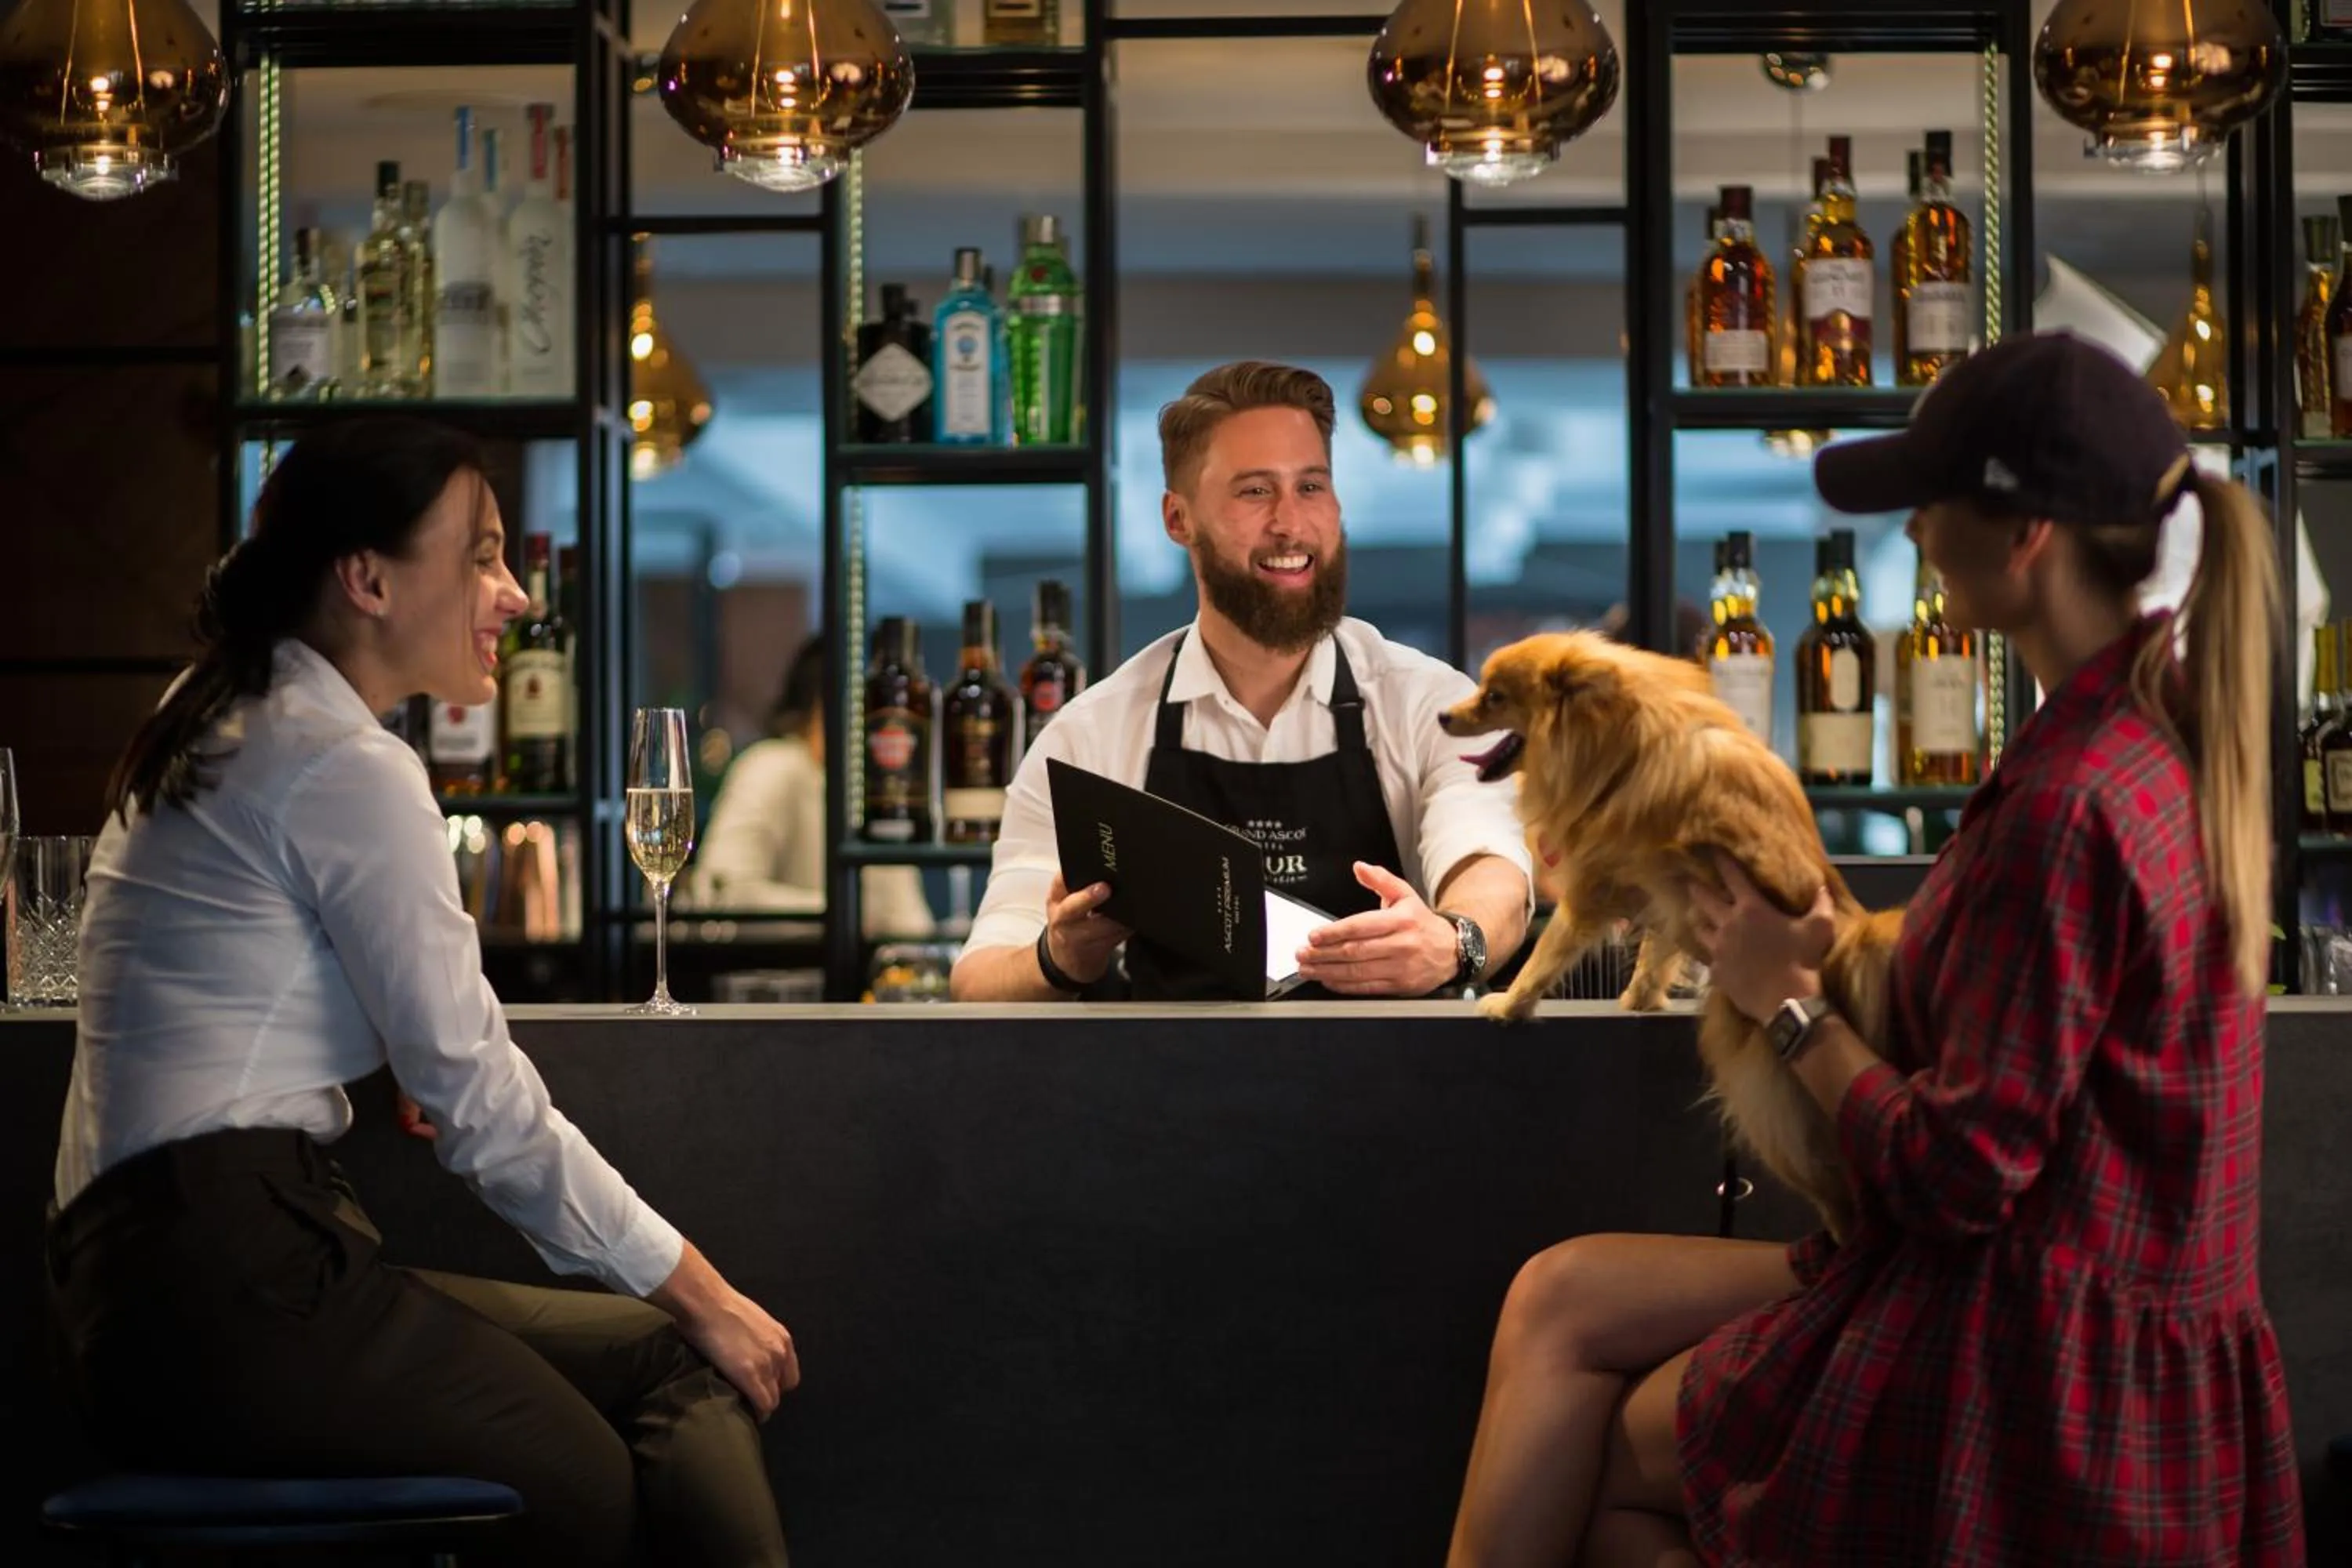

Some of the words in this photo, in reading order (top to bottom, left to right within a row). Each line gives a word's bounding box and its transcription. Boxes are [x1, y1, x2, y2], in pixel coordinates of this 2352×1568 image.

[1098, 822, 1117, 872] MENU
[1265, 855, 1308, 875] UR
[1224, 910, 1232, 954] ASCOT
